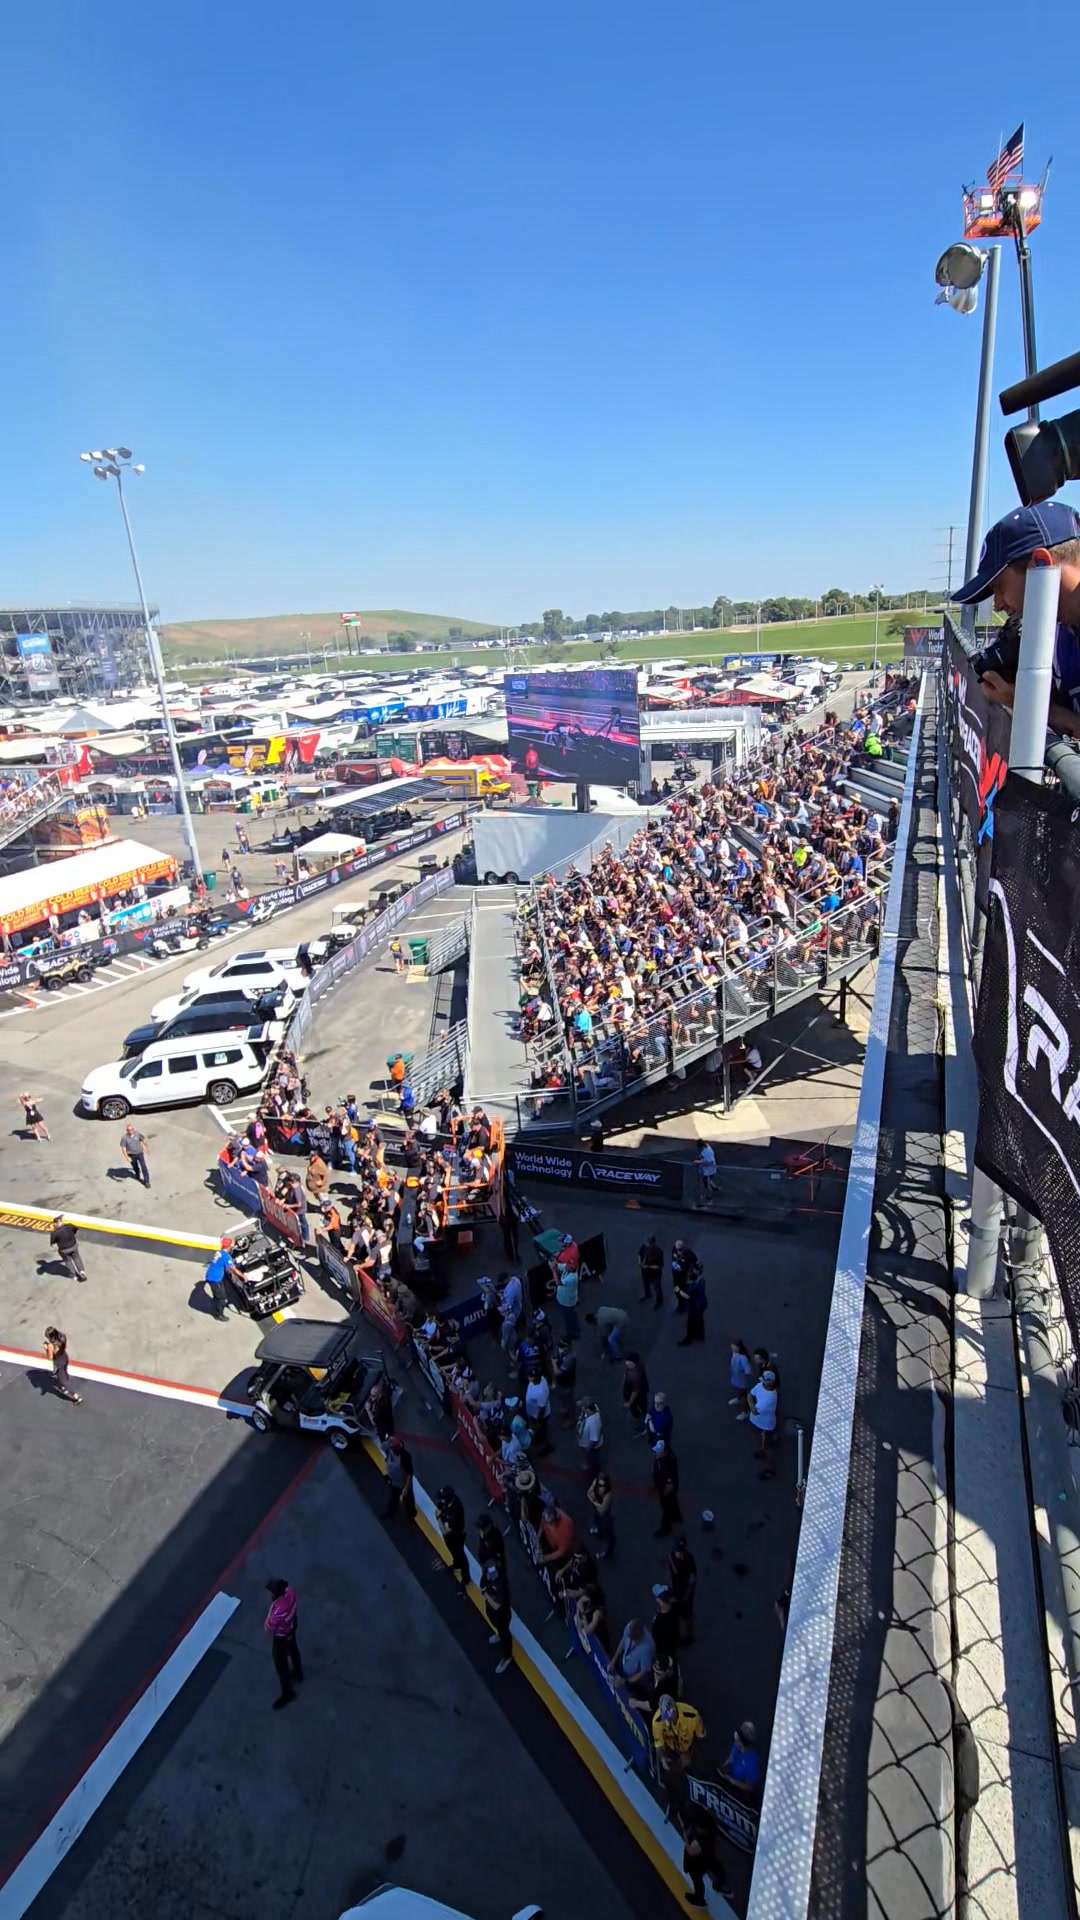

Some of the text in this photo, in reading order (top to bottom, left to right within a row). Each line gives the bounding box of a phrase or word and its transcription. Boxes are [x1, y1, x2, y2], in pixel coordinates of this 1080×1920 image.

[98, 875, 119, 889] COLD
[119, 869, 138, 883] BEER
[48, 891, 73, 905] COLD
[74, 883, 96, 898] BEER
[278, 887, 294, 899] Wide
[1, 909, 25, 924] COLD
[25, 900, 48, 916] BEER
[515, 1152, 573, 1168] World Wide
[515, 1161, 573, 1179] Technology
[596, 1168, 662, 1183] RACEWAY
